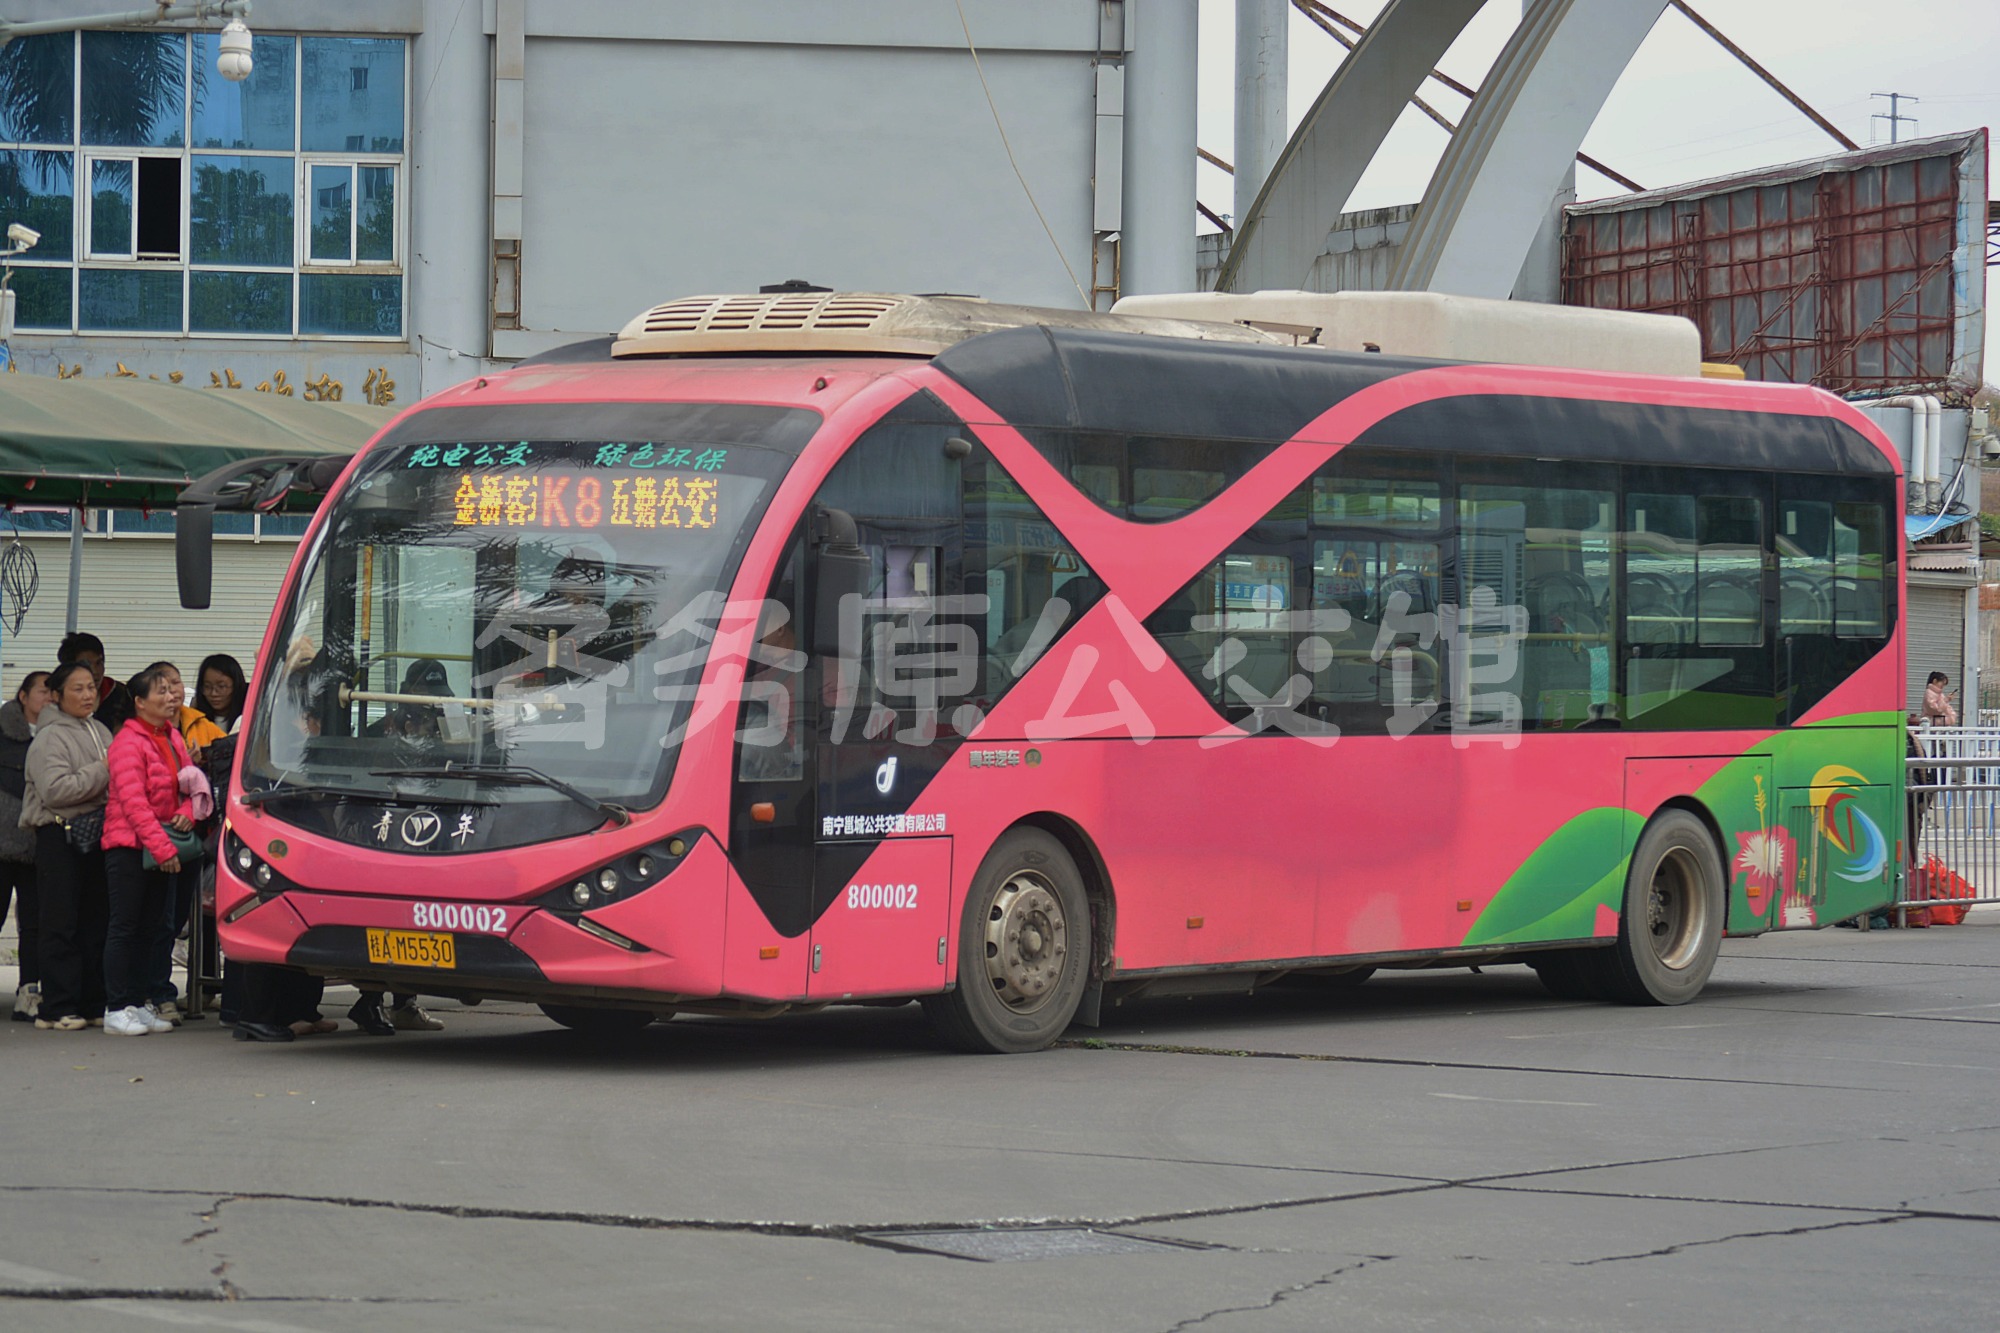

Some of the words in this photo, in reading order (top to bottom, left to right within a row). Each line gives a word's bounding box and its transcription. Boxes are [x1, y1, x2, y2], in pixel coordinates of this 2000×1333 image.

[407, 441, 533, 468] 纯电公交
[594, 442, 728, 472] 绿色环保
[543, 476, 602, 528] K8
[969, 750, 1020, 768] 青年汽车
[823, 813, 947, 836] 南宁邕城公共交通有限公司
[847, 883, 918, 909] 800002
[413, 902, 508, 933] 800002
